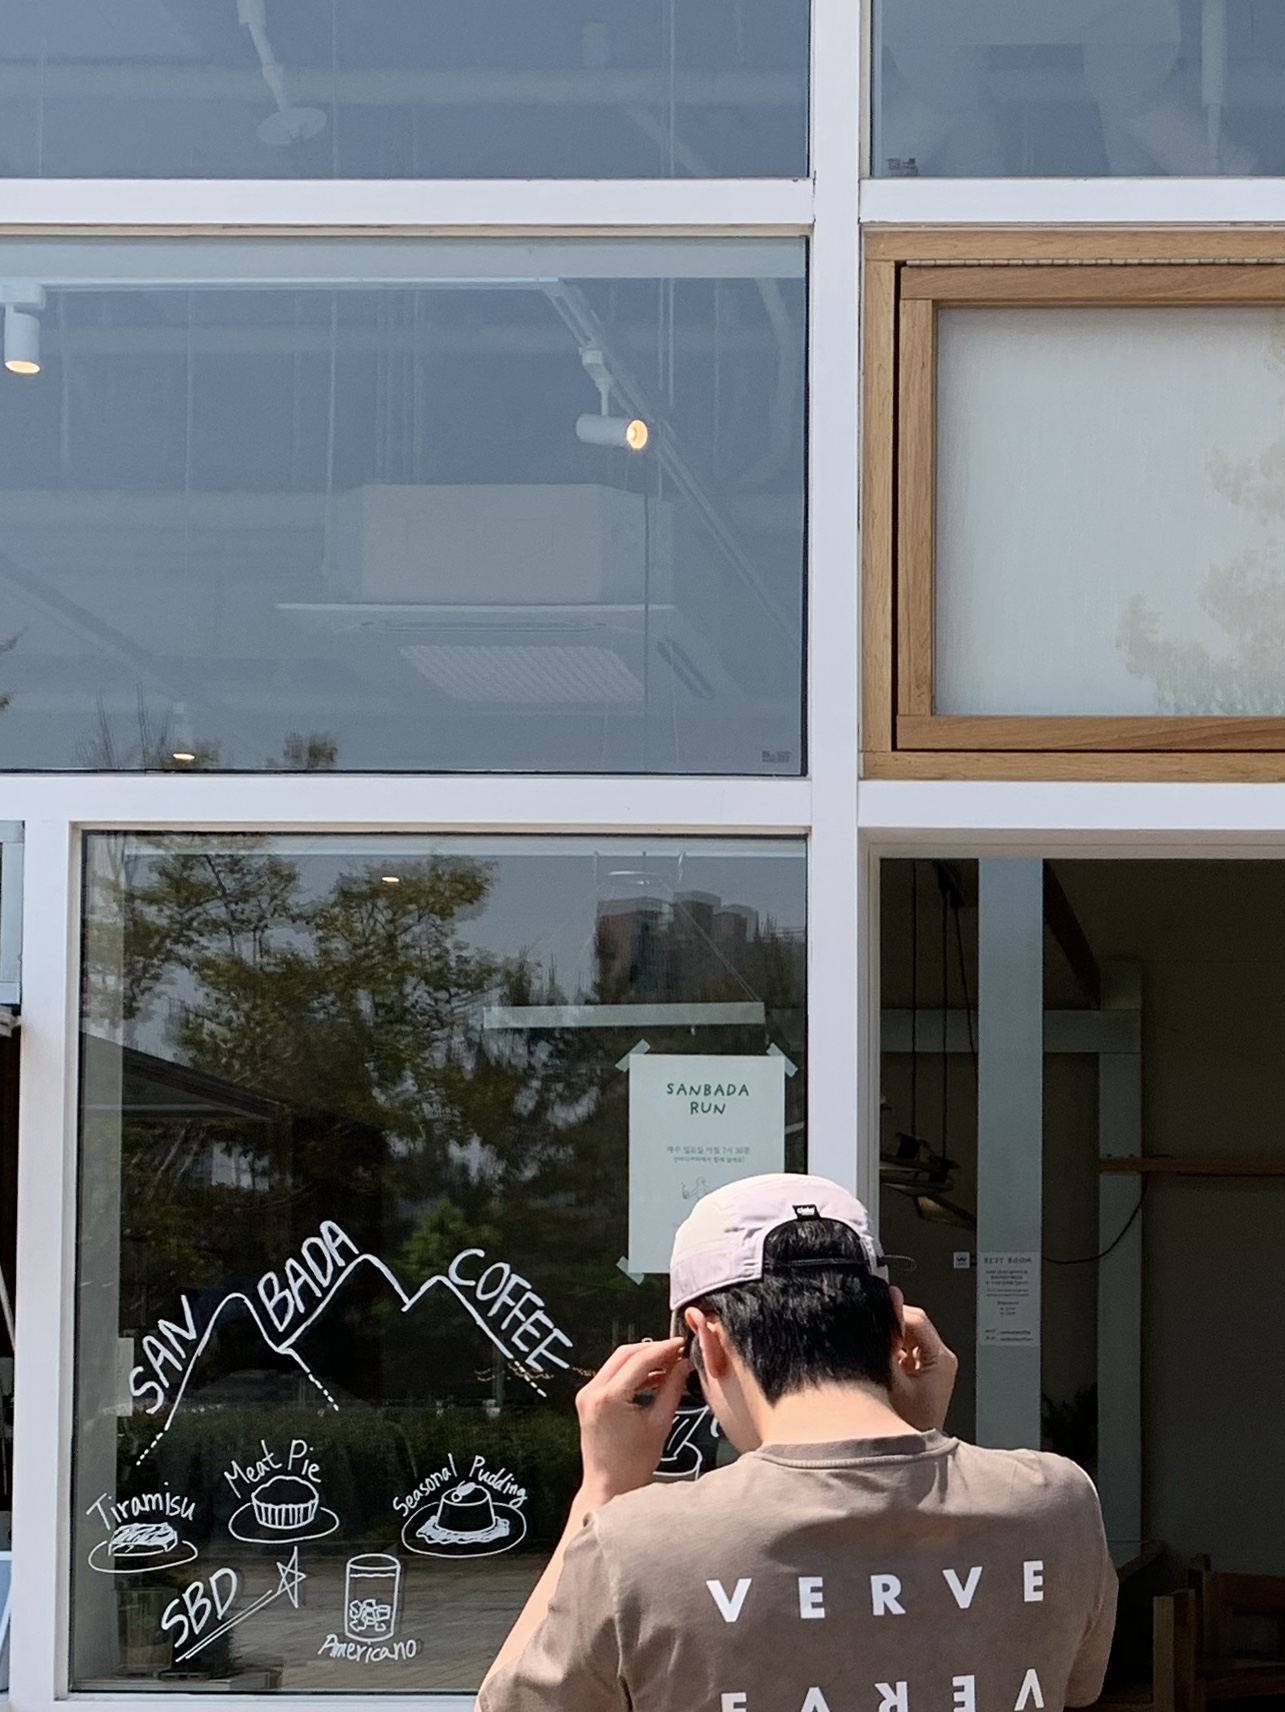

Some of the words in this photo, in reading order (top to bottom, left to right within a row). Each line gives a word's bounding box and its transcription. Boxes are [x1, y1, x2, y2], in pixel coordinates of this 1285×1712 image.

[666, 1083, 749, 1097] SANBADA
[690, 1101, 726, 1115] RUN
[129, 1294, 200, 1414] SAN
[258, 1220, 359, 1332] BADA
[448, 1248, 574, 1371] COFFEE
[223, 1439, 282, 1499] Meat
[288, 1440, 322, 1483] Pie
[393, 1453, 458, 1517] Seasonal
[468, 1455, 528, 1509] Pudding
[86, 1481, 196, 1530] Tiramisu
[161, 1567, 238, 1648] SBD
[705, 1560, 1044, 1623] VERVE
[318, 1633, 418, 1661] Americano
